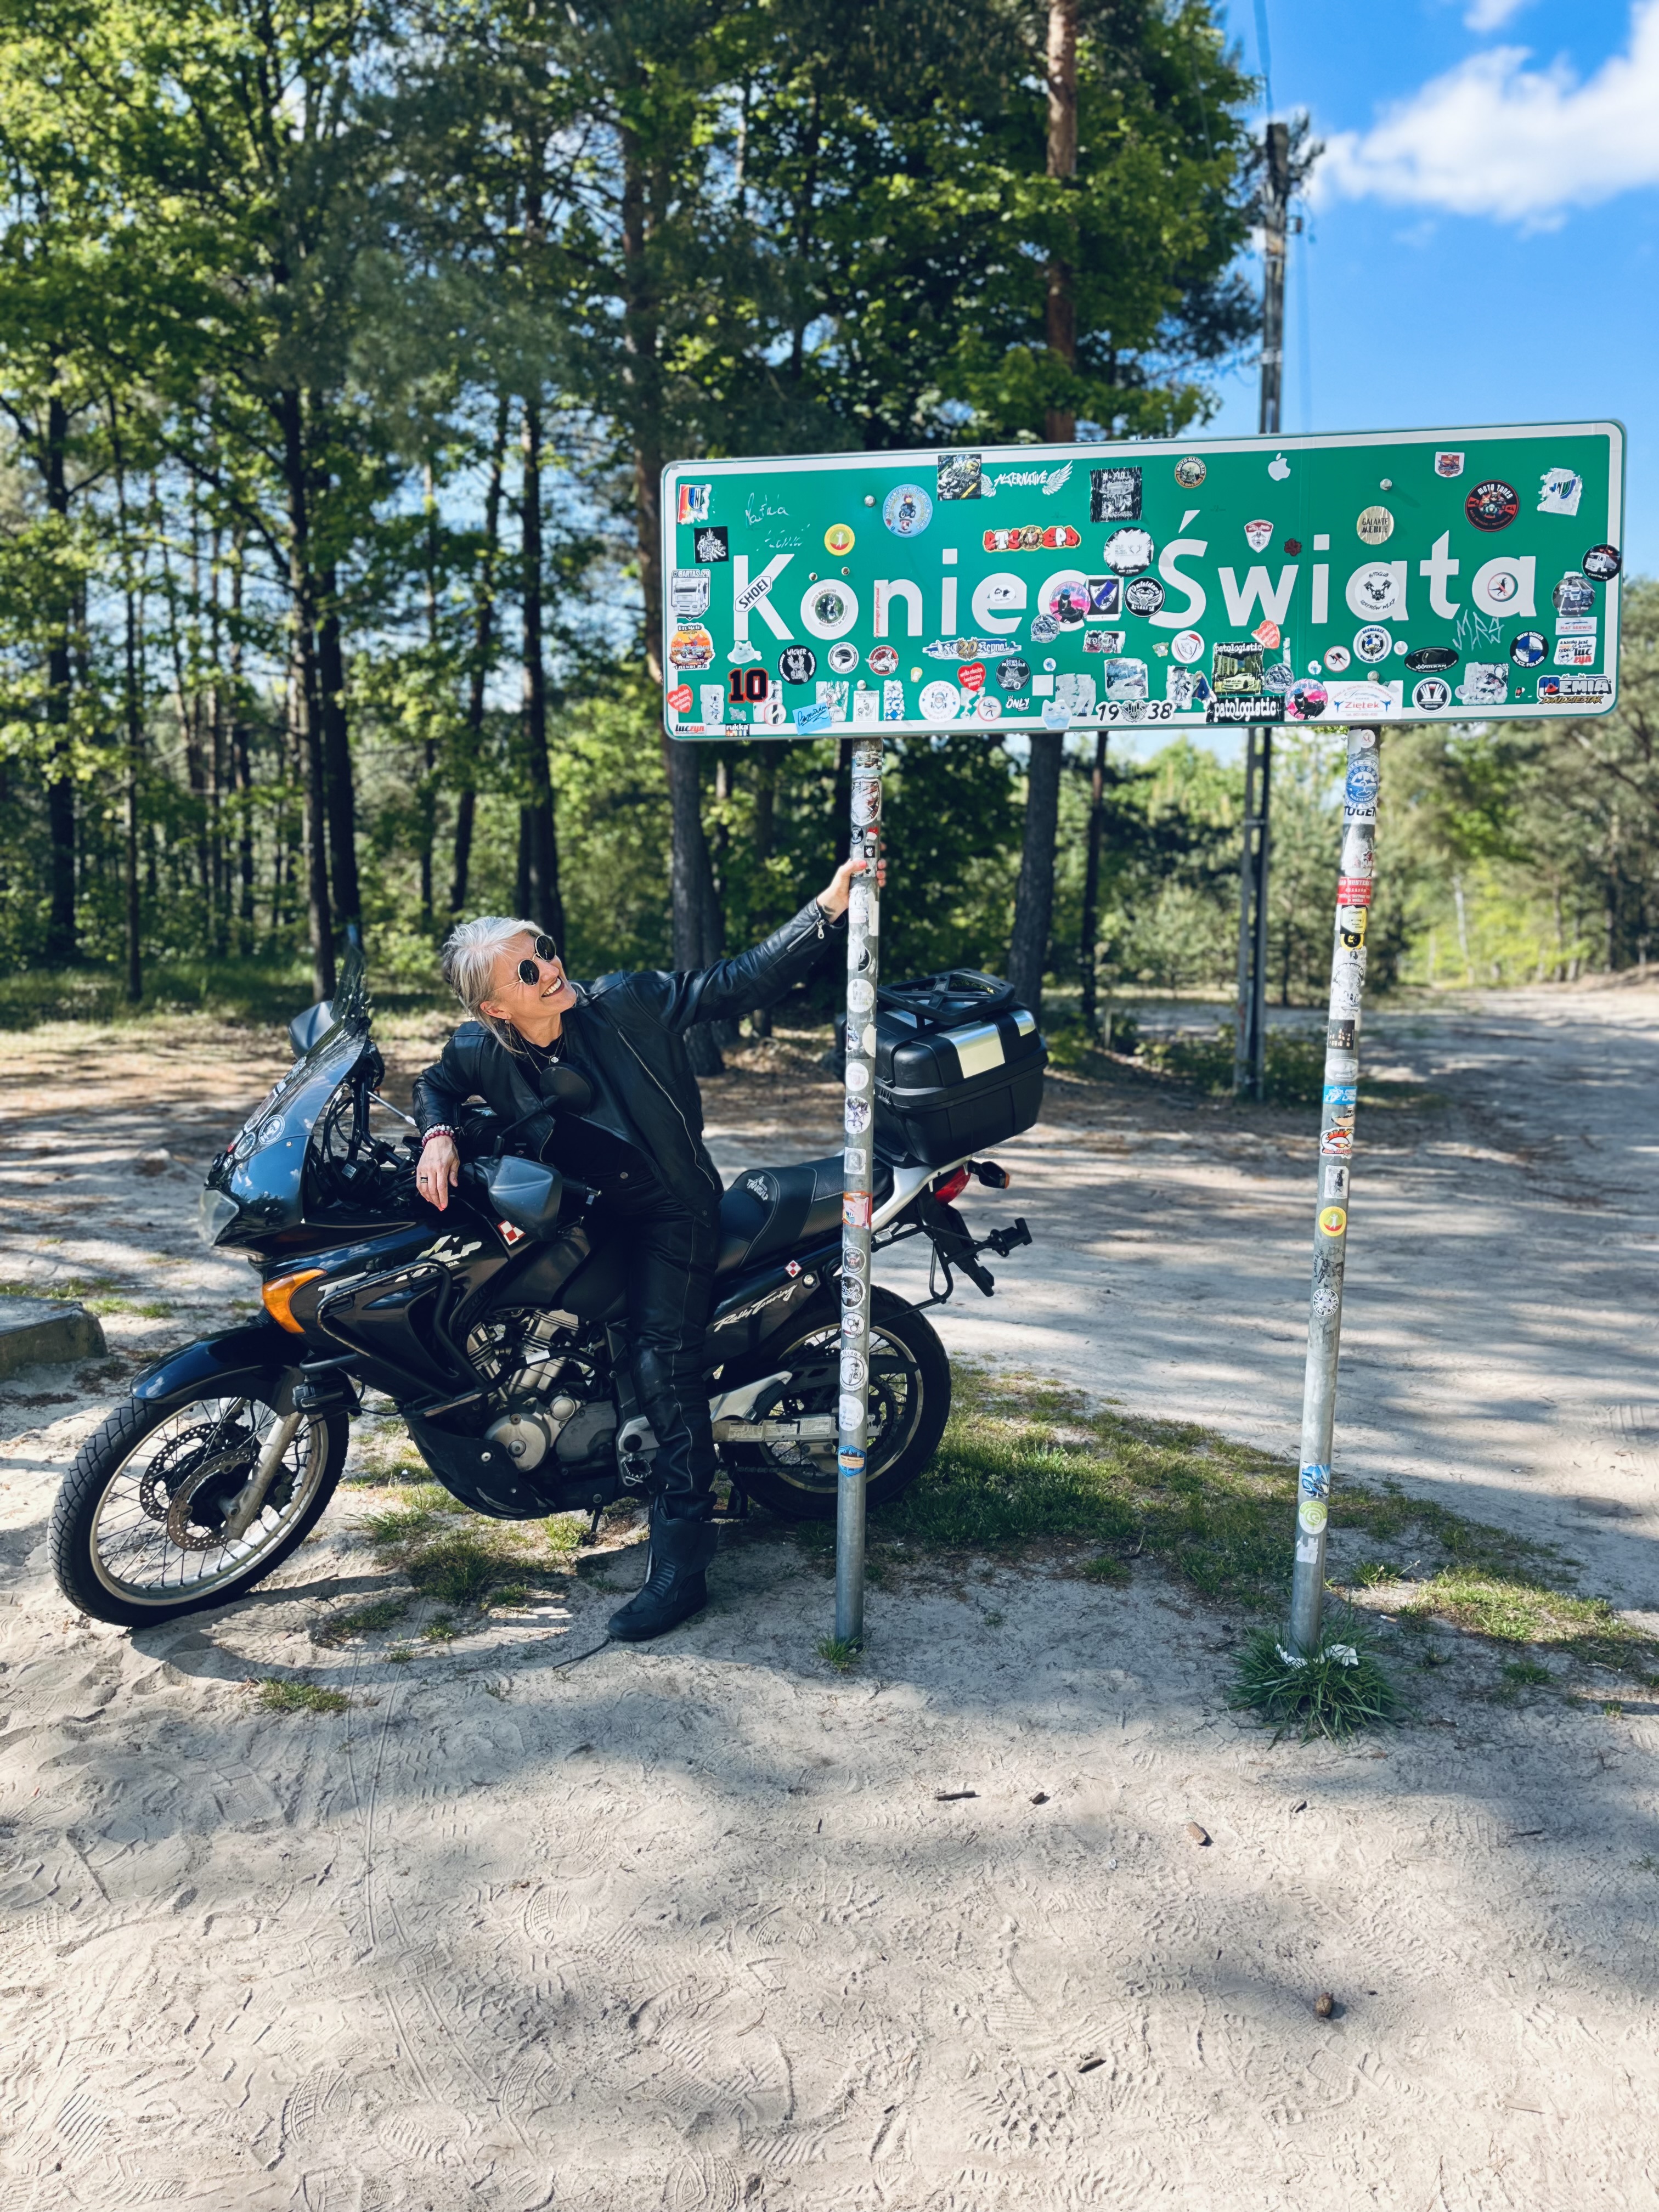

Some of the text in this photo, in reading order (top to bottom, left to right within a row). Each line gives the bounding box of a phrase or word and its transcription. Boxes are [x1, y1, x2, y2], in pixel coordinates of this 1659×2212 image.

[994, 470, 1048, 487] ALTERNATIVE
[1477, 483, 1495, 495] MOTO
[885, 487, 911, 519] Motocyklowa
[732, 509, 1537, 641] Koniec Świata
[738, 579, 769, 609] SHOEI
[1131, 580, 1160, 595] Outsiders
[958, 640, 979, 654] 20
[1214, 642, 1262, 654] patologistic
[728, 668, 769, 703] 10
[1006, 697, 1030, 709] ONLY
[1098, 702, 1173, 721] 19 38
[1214, 697, 1277, 723] patologistic
[1344, 701, 1380, 710] Ziętek
[713, 1284, 798, 1333] Rally Touring
